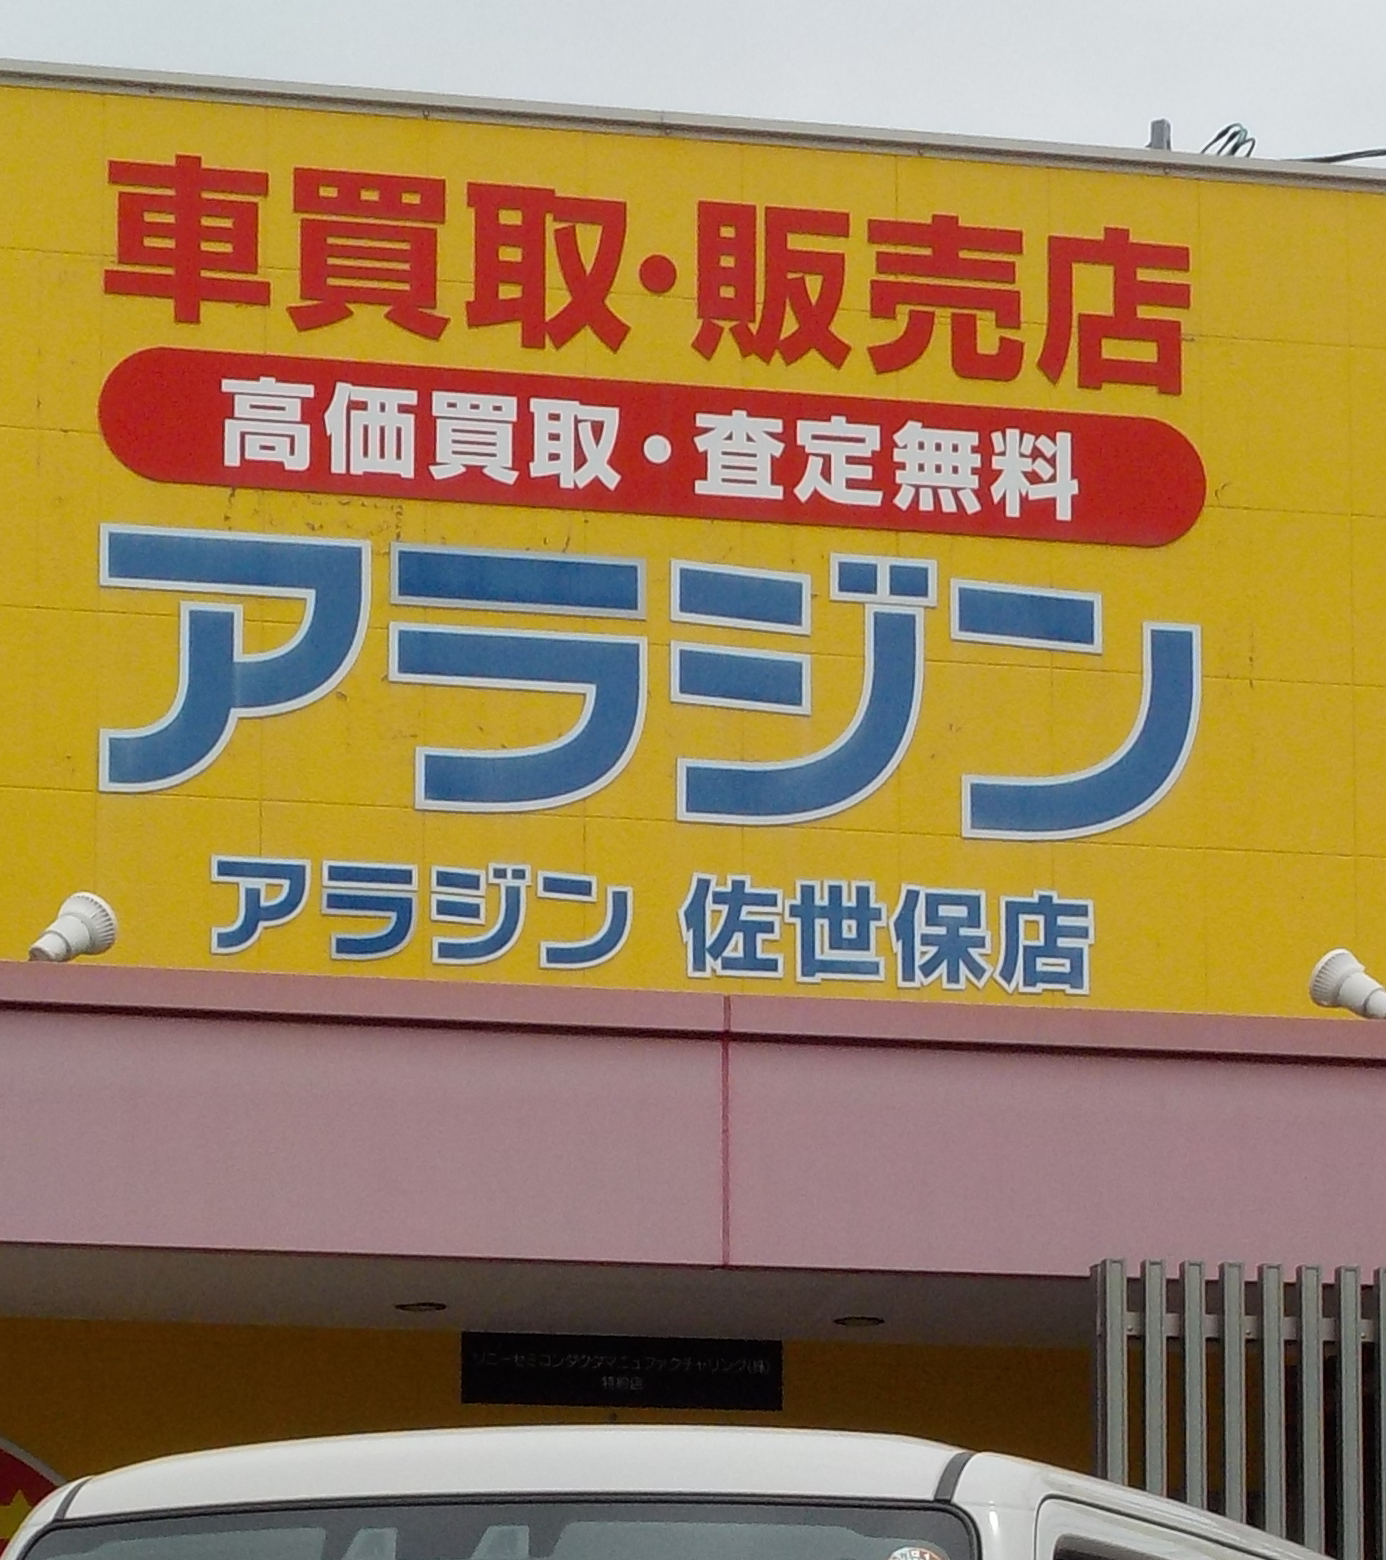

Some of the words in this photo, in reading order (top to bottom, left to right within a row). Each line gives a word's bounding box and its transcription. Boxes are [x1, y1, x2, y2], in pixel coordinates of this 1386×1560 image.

[103, 154, 1191, 395] 車買取・販売店
[221, 377, 1079, 520] 高価買取・査定無料
[99, 523, 1202, 841] アラジン
[210, 855, 633, 968] アラジン
[678, 872, 1094, 996] 佐世保店
